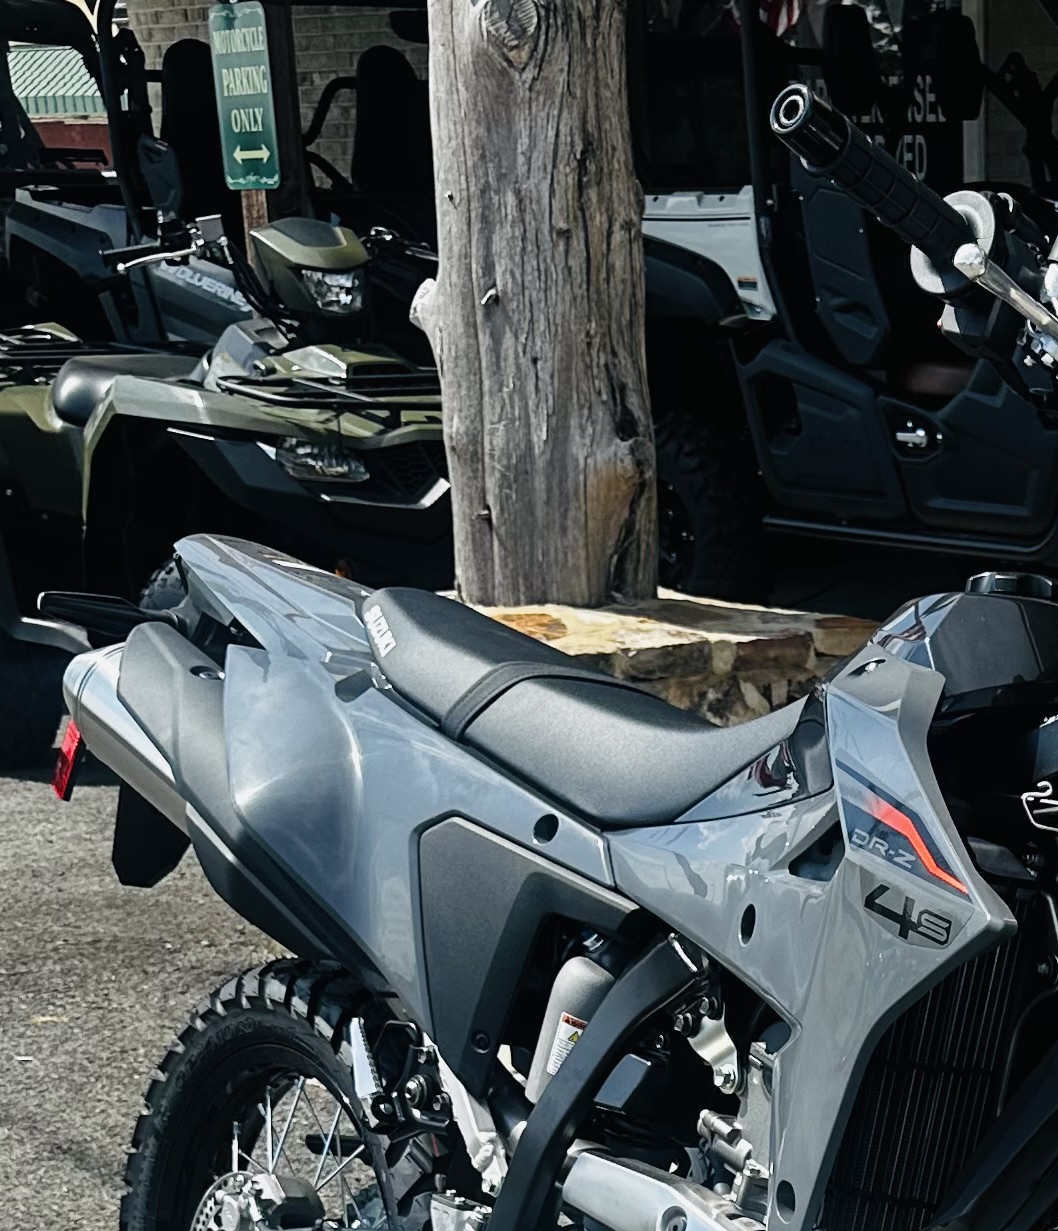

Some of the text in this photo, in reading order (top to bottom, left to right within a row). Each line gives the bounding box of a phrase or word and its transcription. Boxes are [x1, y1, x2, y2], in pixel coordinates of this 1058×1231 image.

[212, 26, 265, 55] MOTORCYCLE
[221, 65, 268, 97] PARKING
[231, 107, 264, 133] ONLY
[364, 604, 397, 658] SUZUKI
[851, 828, 916, 869] DR-Z
[864, 883, 953, 946] 4S
